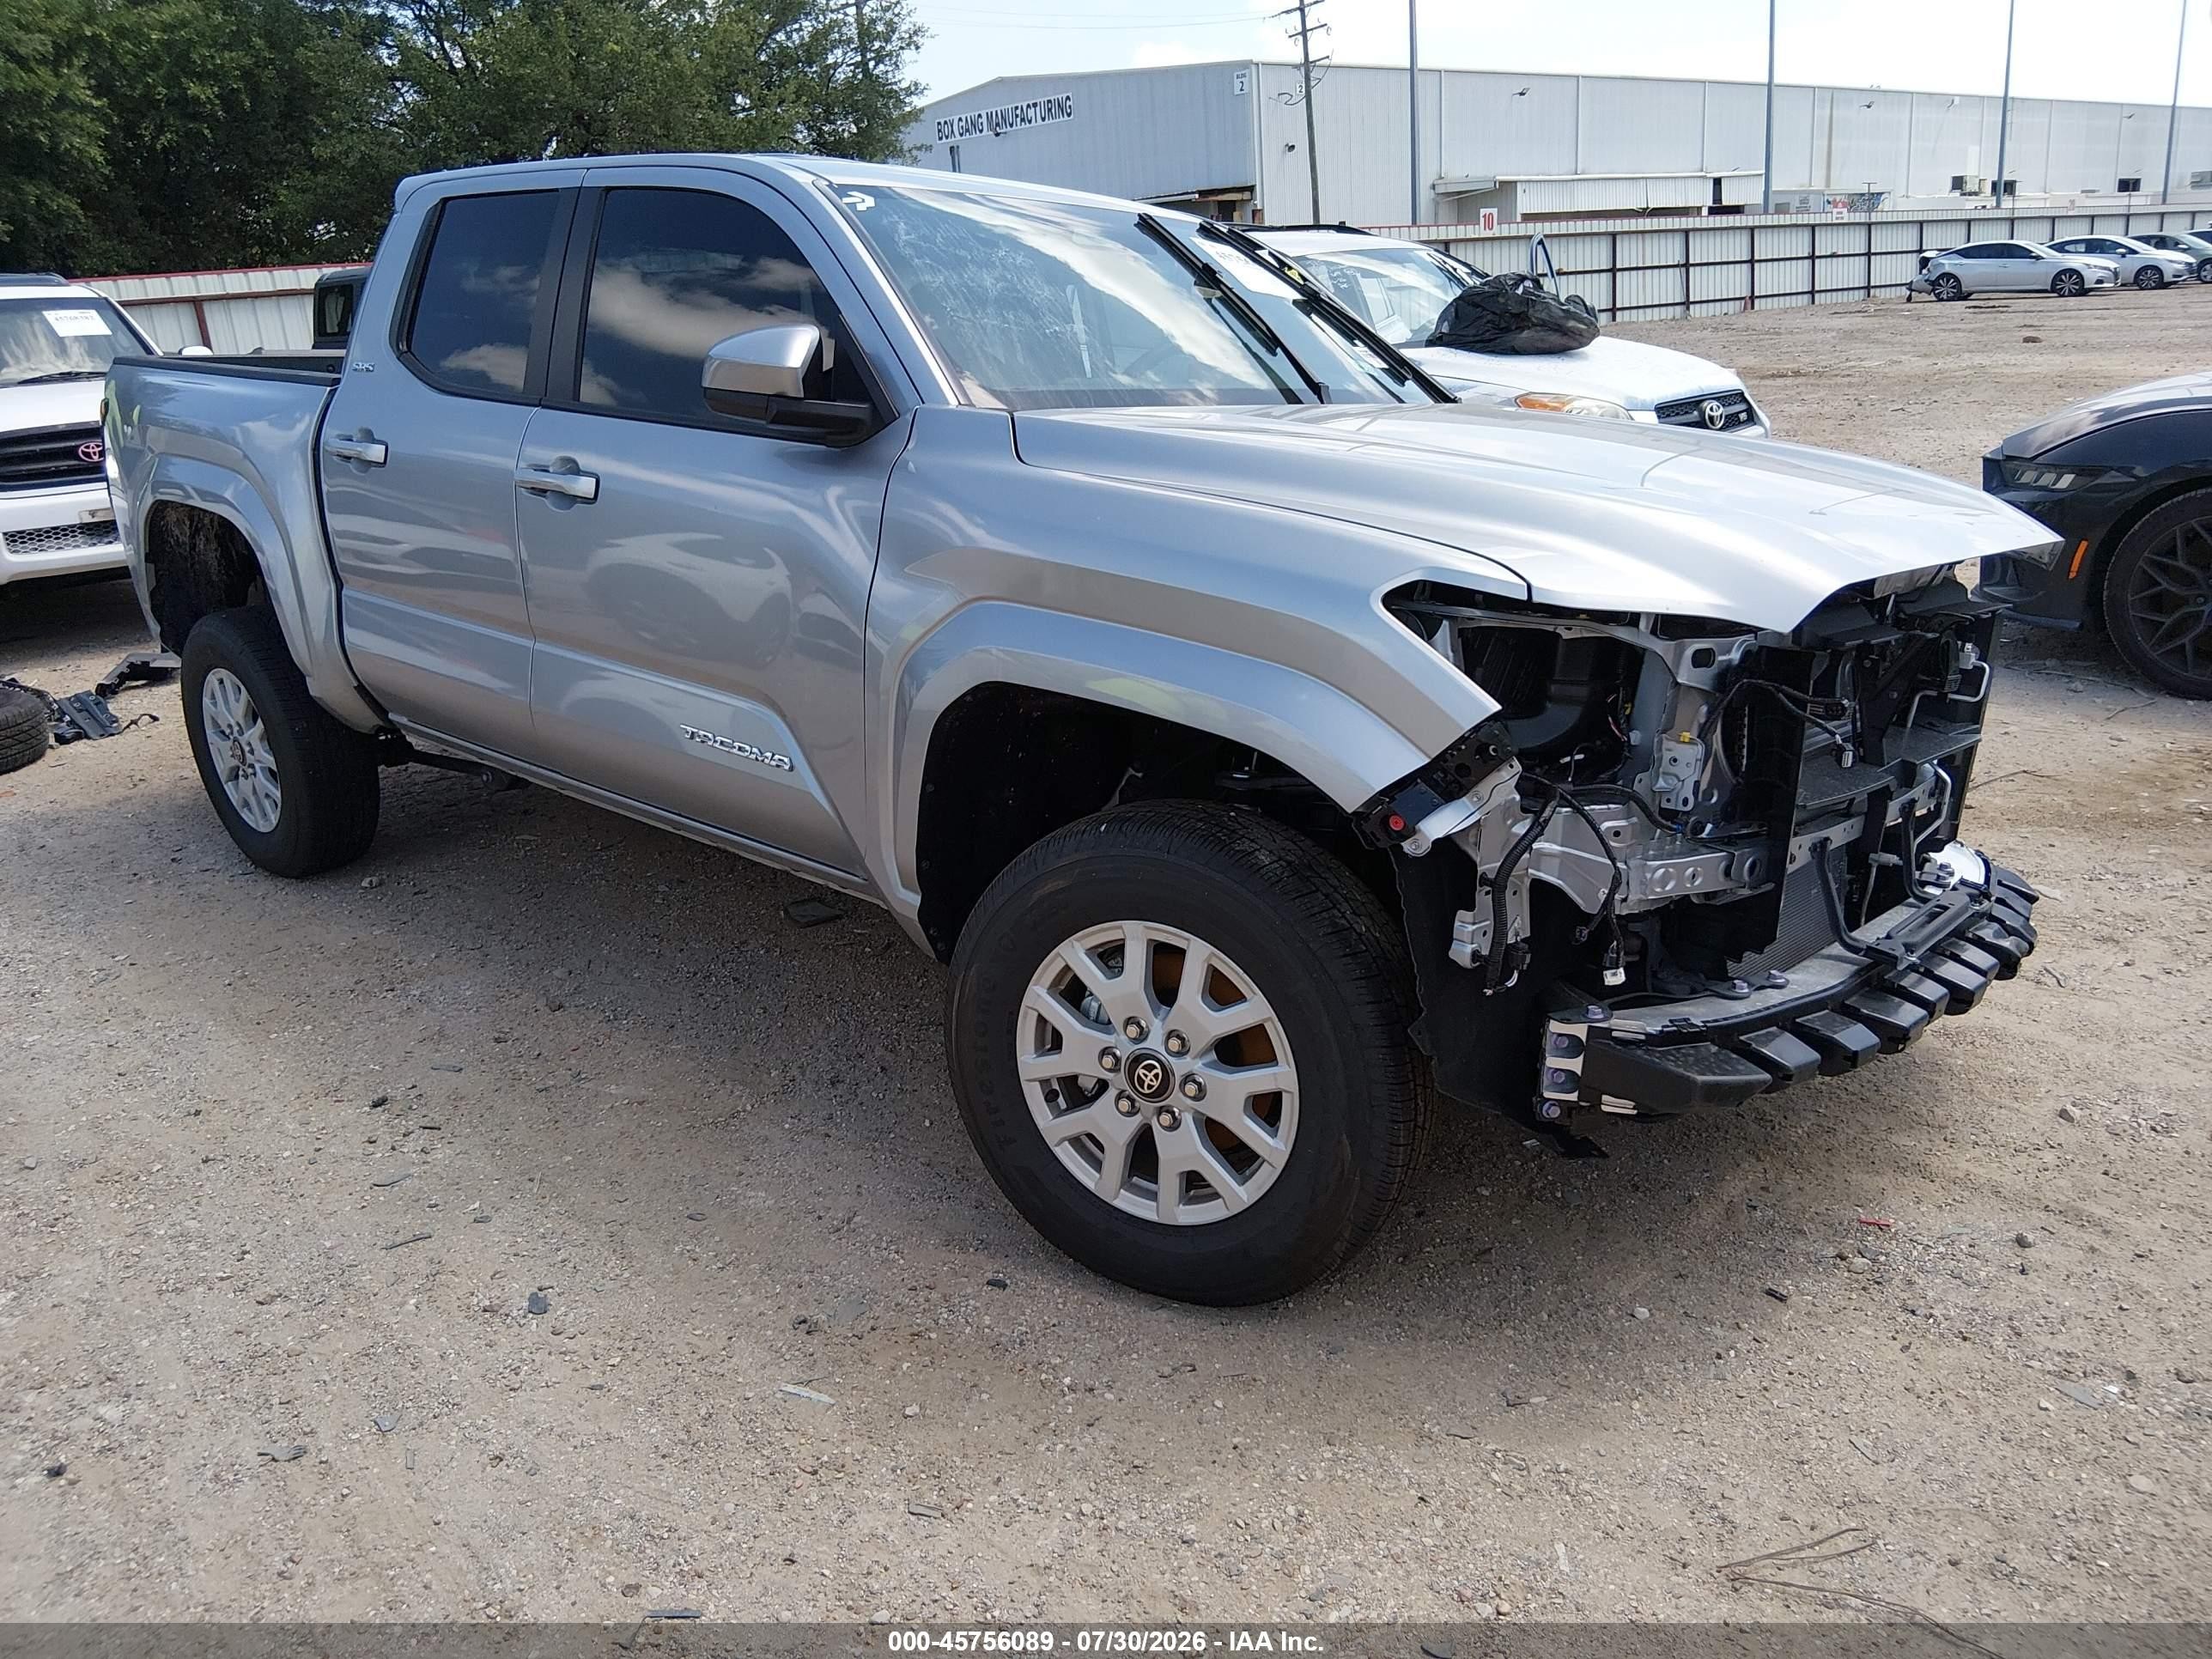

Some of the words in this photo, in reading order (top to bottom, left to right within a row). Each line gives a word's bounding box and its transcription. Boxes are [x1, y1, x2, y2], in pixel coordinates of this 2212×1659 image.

[1239, 81, 1245, 92] 2
[1297, 84, 1304, 94] 2
[936, 118, 956, 141] BOX
[957, 113, 984, 138] GANG
[986, 94, 1073, 132] MANUFACTURING
[1481, 212, 1494, 231] 10
[1738, 411, 1747, 422] V6
[679, 723, 794, 772] TACOMA
